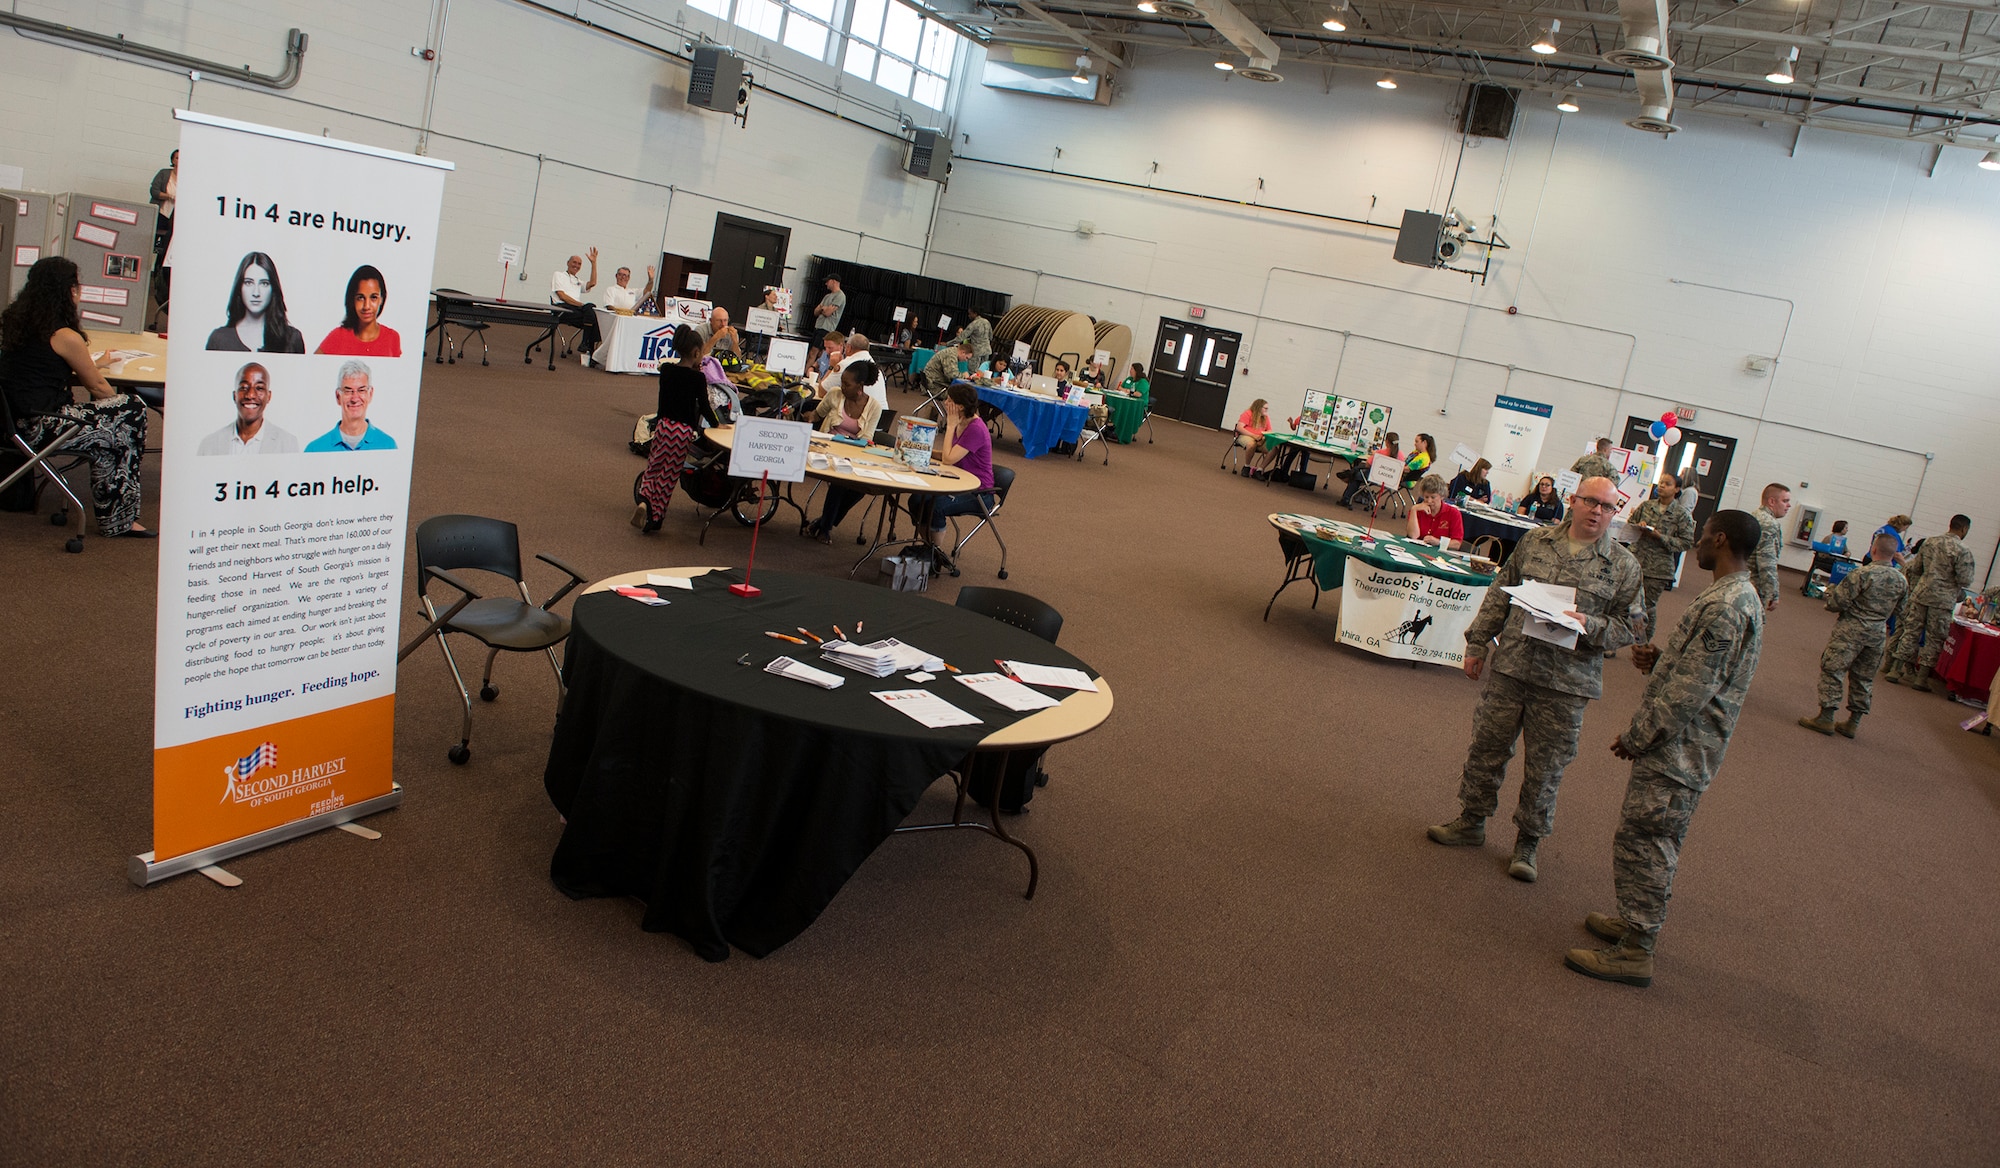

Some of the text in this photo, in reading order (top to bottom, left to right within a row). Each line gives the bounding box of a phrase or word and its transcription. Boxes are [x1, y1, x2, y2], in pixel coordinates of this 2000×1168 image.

[216, 196, 411, 242] 1 in 4 are hungry.
[749, 442, 783, 451] HARVEST
[759, 431, 788, 440] SECOND
[754, 455, 785, 464] GEORGIA
[1380, 464, 1396, 474] JACOB'S
[215, 475, 379, 502] 3 in 4 can help.
[1378, 470, 1394, 480] LADDER
[218, 526, 244, 538] people
[259, 524, 281, 533] South
[284, 522, 313, 530] Georgia
[316, 519, 334, 528] don't
[336, 517, 355, 525] know
[357, 515, 377, 523] where
[380, 514, 393, 523] they
[188, 562, 216, 571] friends
[218, 559, 232, 568] and
[234, 556, 272, 567] neighbors
[274, 554, 289, 562] who
[292, 550, 320, 561] struggle
[338, 547, 360, 556] hunger
[377, 541, 391, 551] daily
[189, 546, 203, 555] will
[206, 546, 218, 555] get
[221, 543, 239, 552] their
[242, 541, 260, 549] next
[263, 540, 282, 548] meal.
[285, 537, 305, 545] That's
[308, 535, 327, 543] more
[346, 529, 370, 540] 160,000
[187, 594, 215, 604] feeding
[221, 590, 243, 598] those
[249, 587, 256, 596] in
[262, 584, 282, 594] need.
[290, 581, 302, 590] We
[324, 577, 335, 585] the
[340, 573, 363, 584] region's
[368, 570, 389, 579] largest
[188, 579, 209, 588] basis.
[219, 573, 247, 584] Second
[253, 570, 282, 580] Harvest
[286, 567, 294, 576] of
[298, 565, 319, 574] South
[324, 560, 353, 572] Georgia's
[358, 558, 381, 566] mission
[1368, 572, 1472, 602] Jacobs' Ladder
[187, 605, 236, 620] hunger-relief
[242, 599, 289, 612] organization.
[317, 592, 342, 601] operate
[355, 587, 377, 595] variety
[382, 583, 388, 591] of
[1355, 578, 1406, 599] Therapeutic
[1408, 594, 1432, 607] Riding
[1436, 600, 1461, 612] Center
[185, 642, 206, 653] cycle
[209, 640, 217, 648] of
[220, 636, 250, 648] poverty
[302, 624, 315, 633] Our
[319, 620, 337, 630] work
[339, 617, 352, 627] isn't
[354, 616, 366, 625] just
[368, 612, 386, 621] about
[186, 624, 223, 637] programs
[226, 620, 244, 629] each
[248, 617, 270, 626] aimed
[282, 611, 306, 621] ending
[309, 608, 331, 619] hunger
[334, 604, 346, 613] and
[348, 600, 374, 612] breaking
[377, 598, 387, 606] the
[185, 654, 229, 668] distributing
[234, 650, 253, 659] food
[270, 643, 295, 653] hungry
[300, 637, 325, 649] people;
[346, 630, 364, 639] about
[367, 625, 385, 636] giving
[1366, 637, 1380, 648] GA
[1411, 646, 1462, 662] 229.794.1188
[184, 673, 211, 685] people
[214, 669, 226, 678] the
[228, 665, 249, 676] hope
[252, 662, 266, 671] that
[268, 656, 305, 667] tomorrow
[331, 647, 350, 656] better
[352, 644, 366, 652] than
[368, 639, 385, 650] today.
[184, 669, 380, 719] Fighting hunger. Feeding hope.
[236, 757, 346, 800] SECOND HARVEST
[250, 778, 332, 808] OF SOUTH GEORGIA
[310, 801, 344, 816] AMERICA
[311, 793, 344, 810] FEEDING
